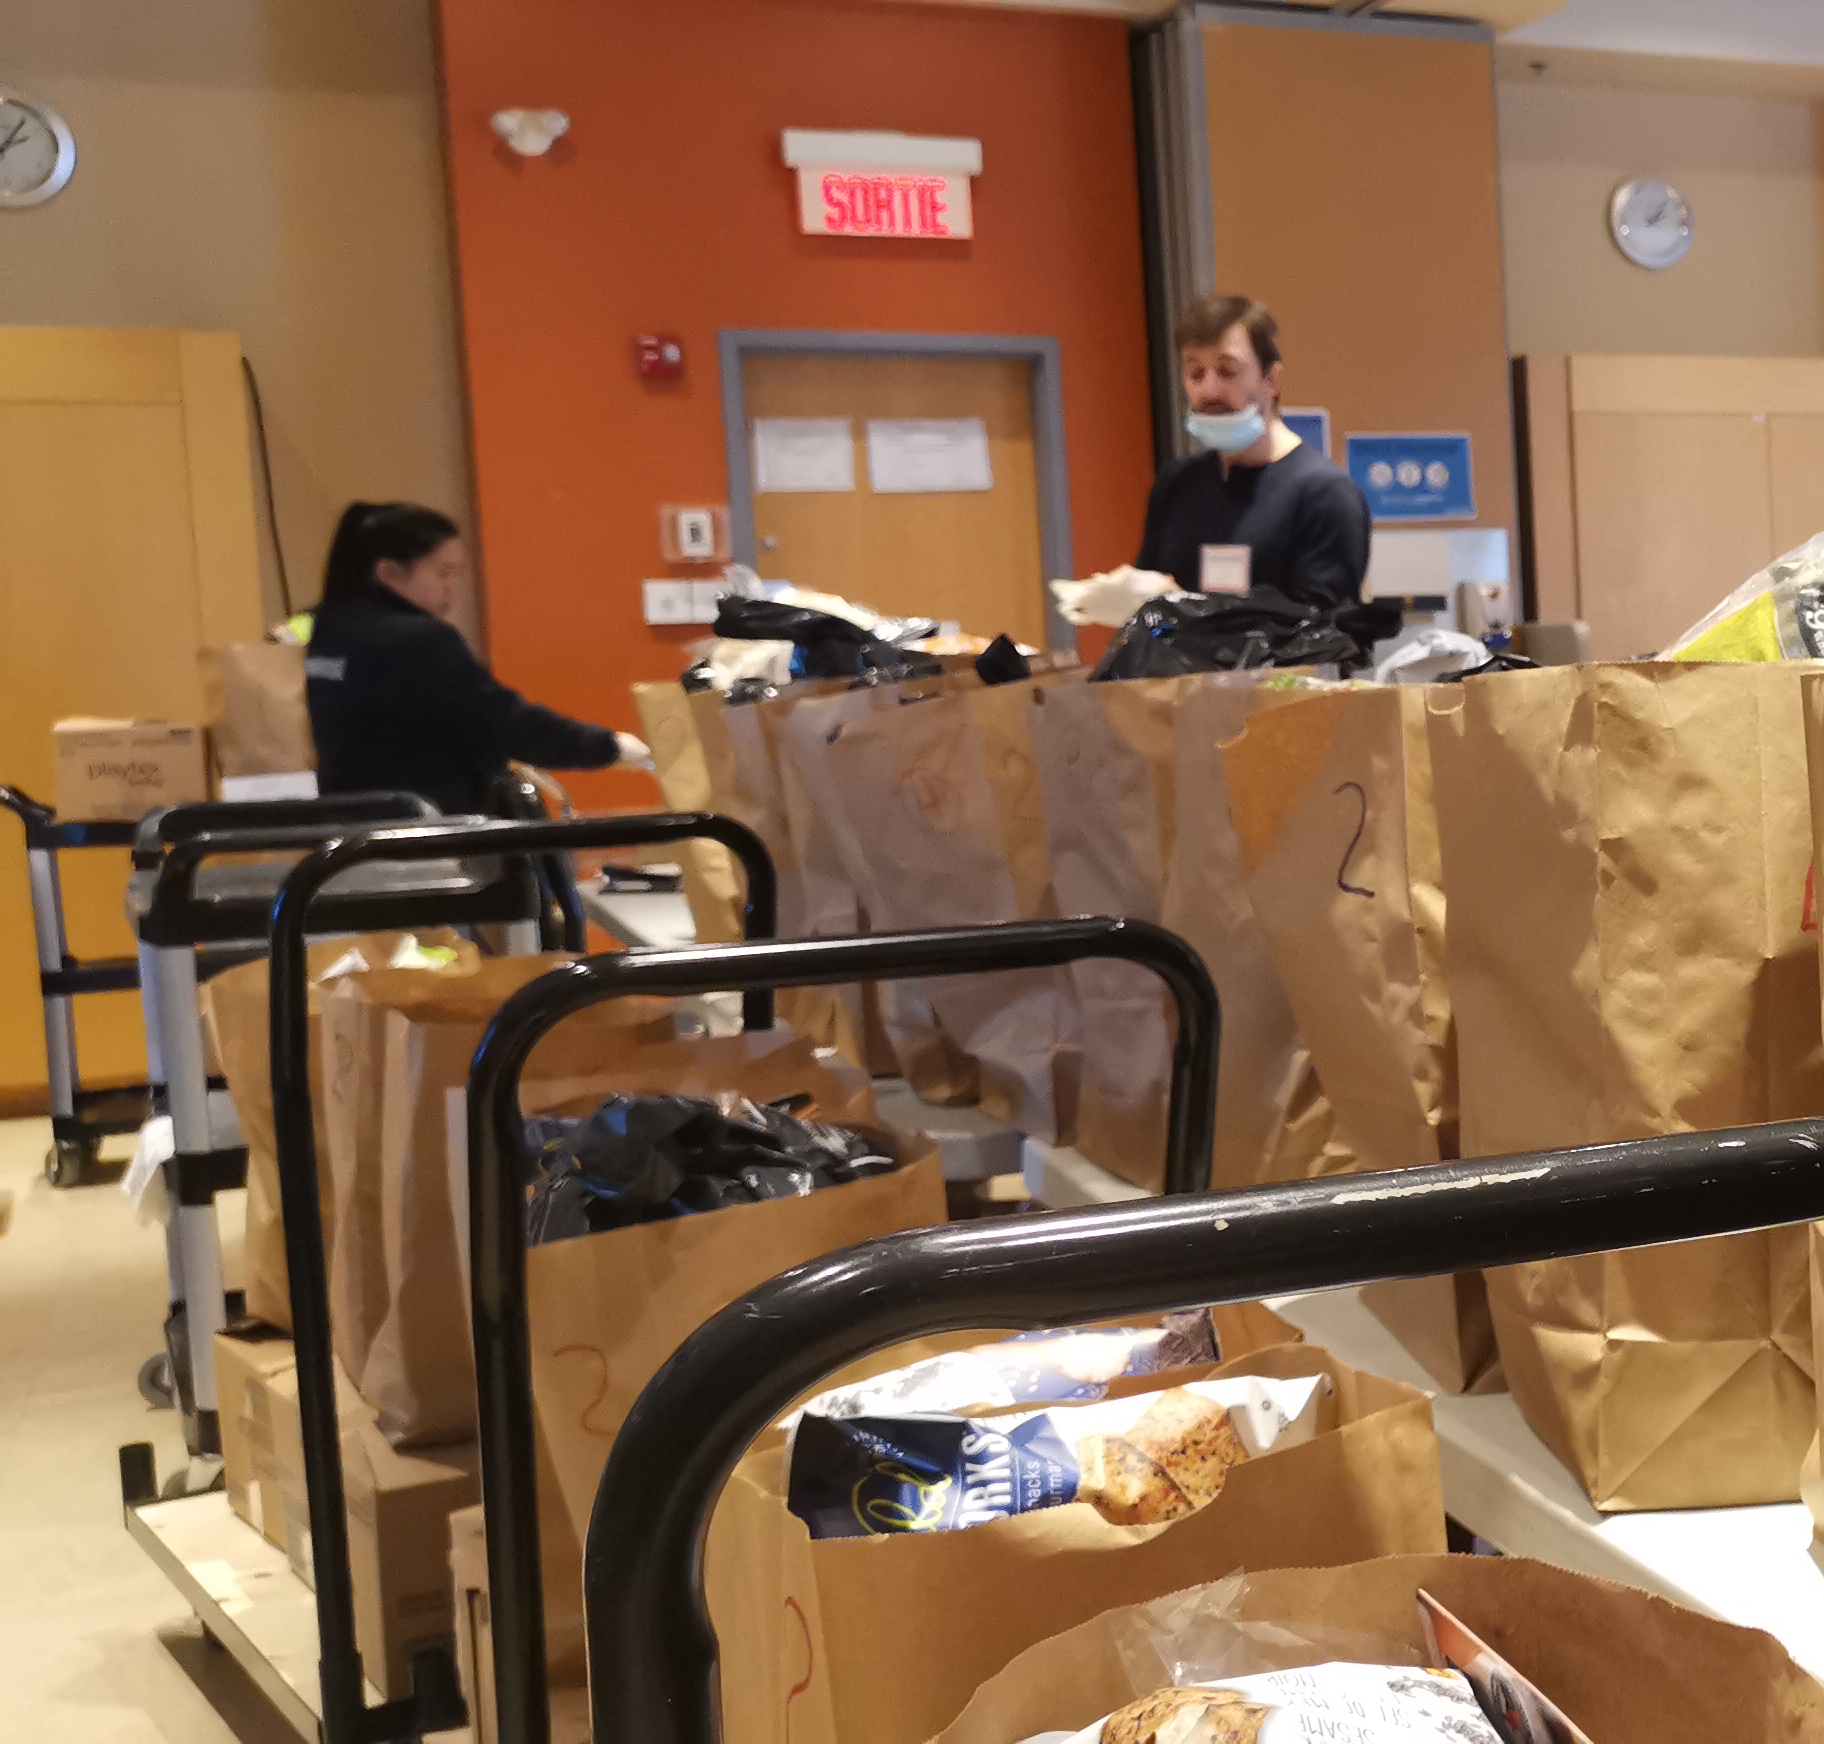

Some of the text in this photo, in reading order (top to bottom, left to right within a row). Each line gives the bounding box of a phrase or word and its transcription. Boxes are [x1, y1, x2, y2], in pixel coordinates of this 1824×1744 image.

[821, 173, 951, 236] SORTIE
[1334, 781, 1376, 899] 2
[553, 1344, 617, 1437] 2
[959, 1432, 1012, 1530] ORKS
[1023, 1460, 1041, 1508] nacks
